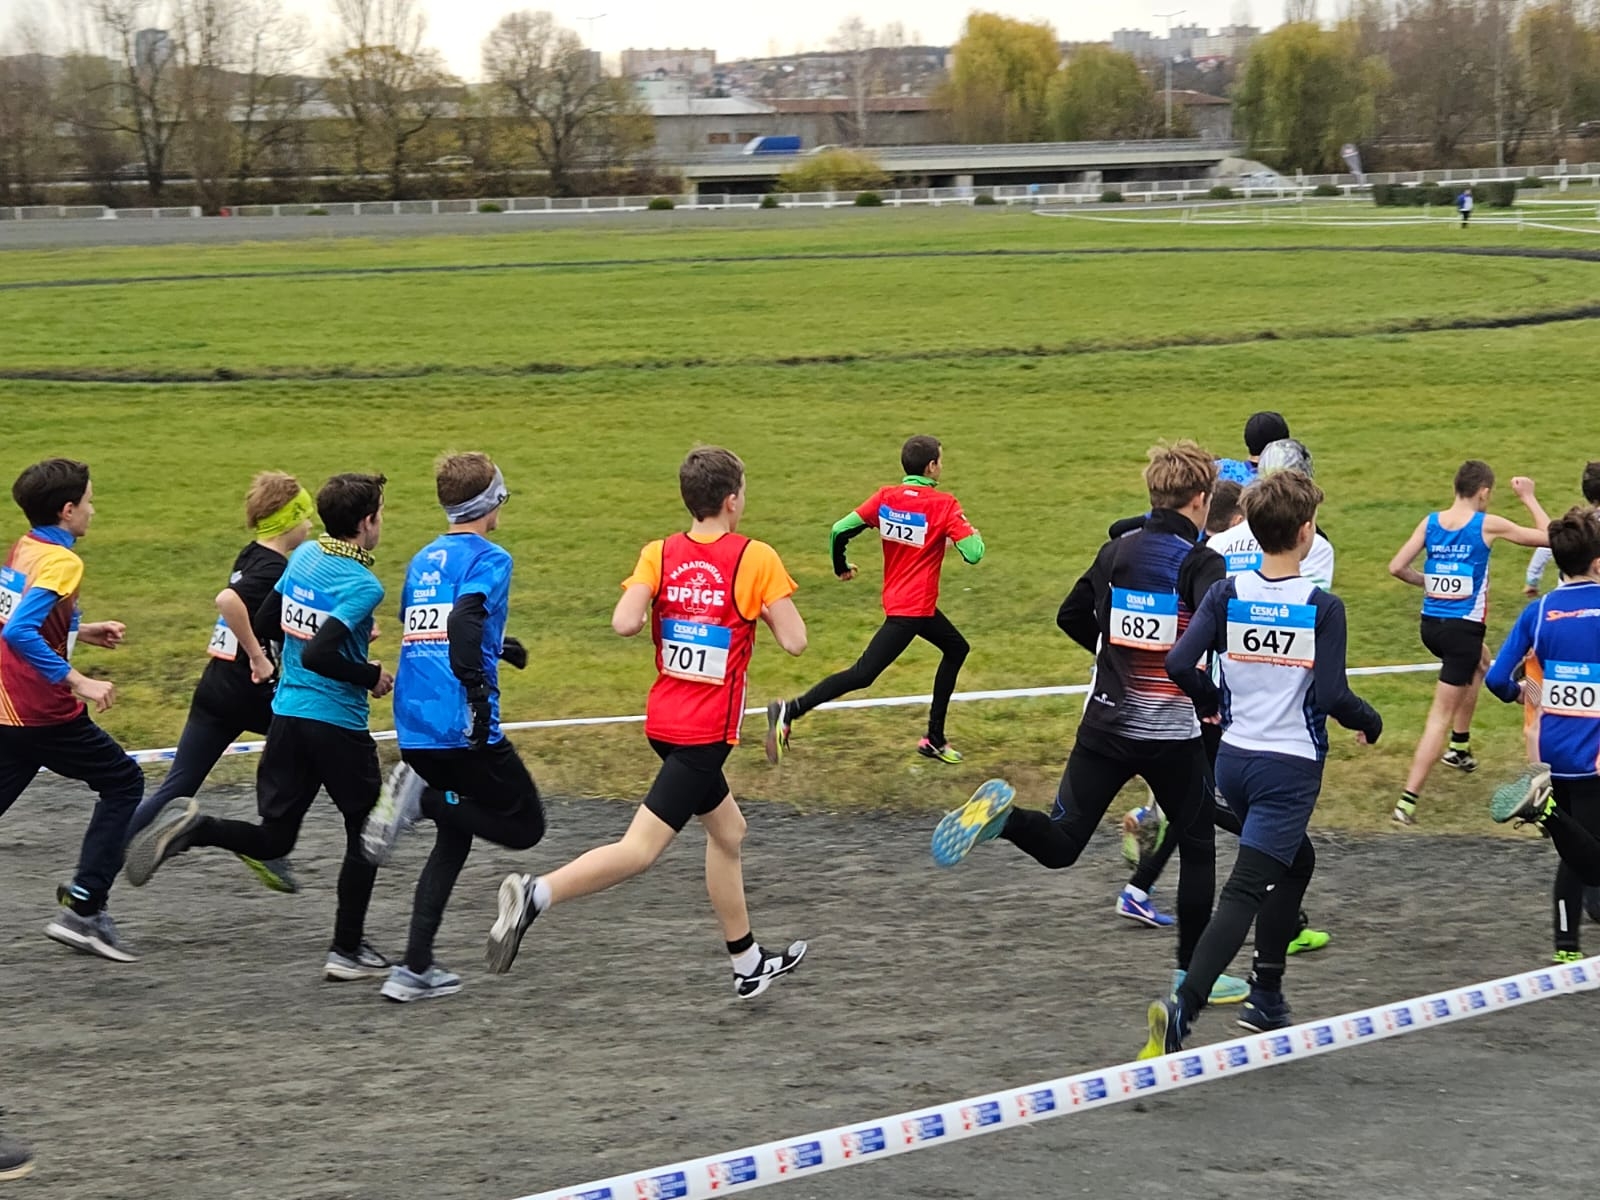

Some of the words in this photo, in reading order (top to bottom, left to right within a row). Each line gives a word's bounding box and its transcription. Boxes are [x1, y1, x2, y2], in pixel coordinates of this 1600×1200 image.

[885, 522, 913, 541] 712
[1431, 577, 1462, 593] 709
[285, 603, 319, 634] 644
[409, 608, 439, 631] 622
[1250, 604, 1279, 617] ČESKÁ
[1121, 615, 1160, 641] 682
[1243, 628, 1296, 655] 647
[668, 644, 707, 672] 701
[1550, 684, 1595, 708] 680
